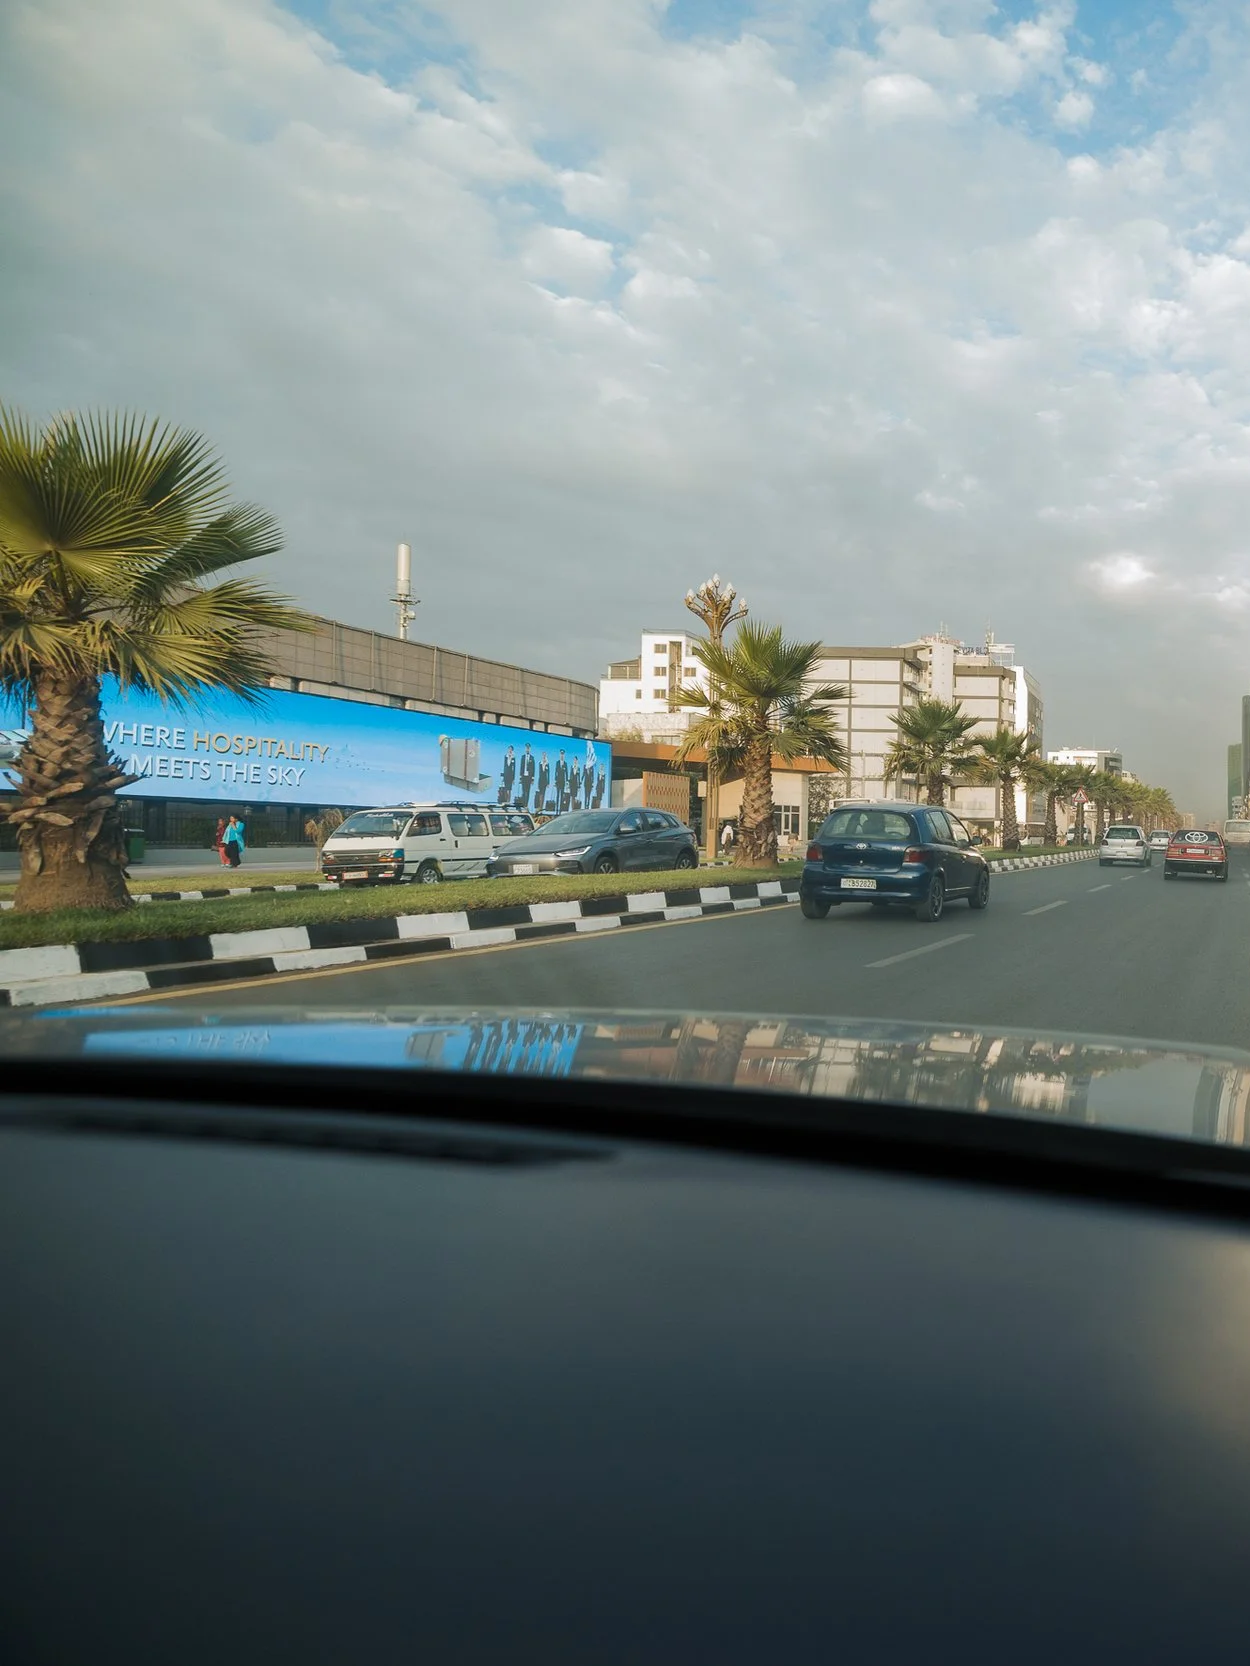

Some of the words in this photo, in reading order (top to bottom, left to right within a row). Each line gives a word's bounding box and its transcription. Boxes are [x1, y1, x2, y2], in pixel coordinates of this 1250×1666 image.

[193, 730, 330, 763] HOSPITALITY
[130, 754, 212, 781] MEETS
[216, 760, 263, 785] THE
[267, 765, 306, 787] SKY
